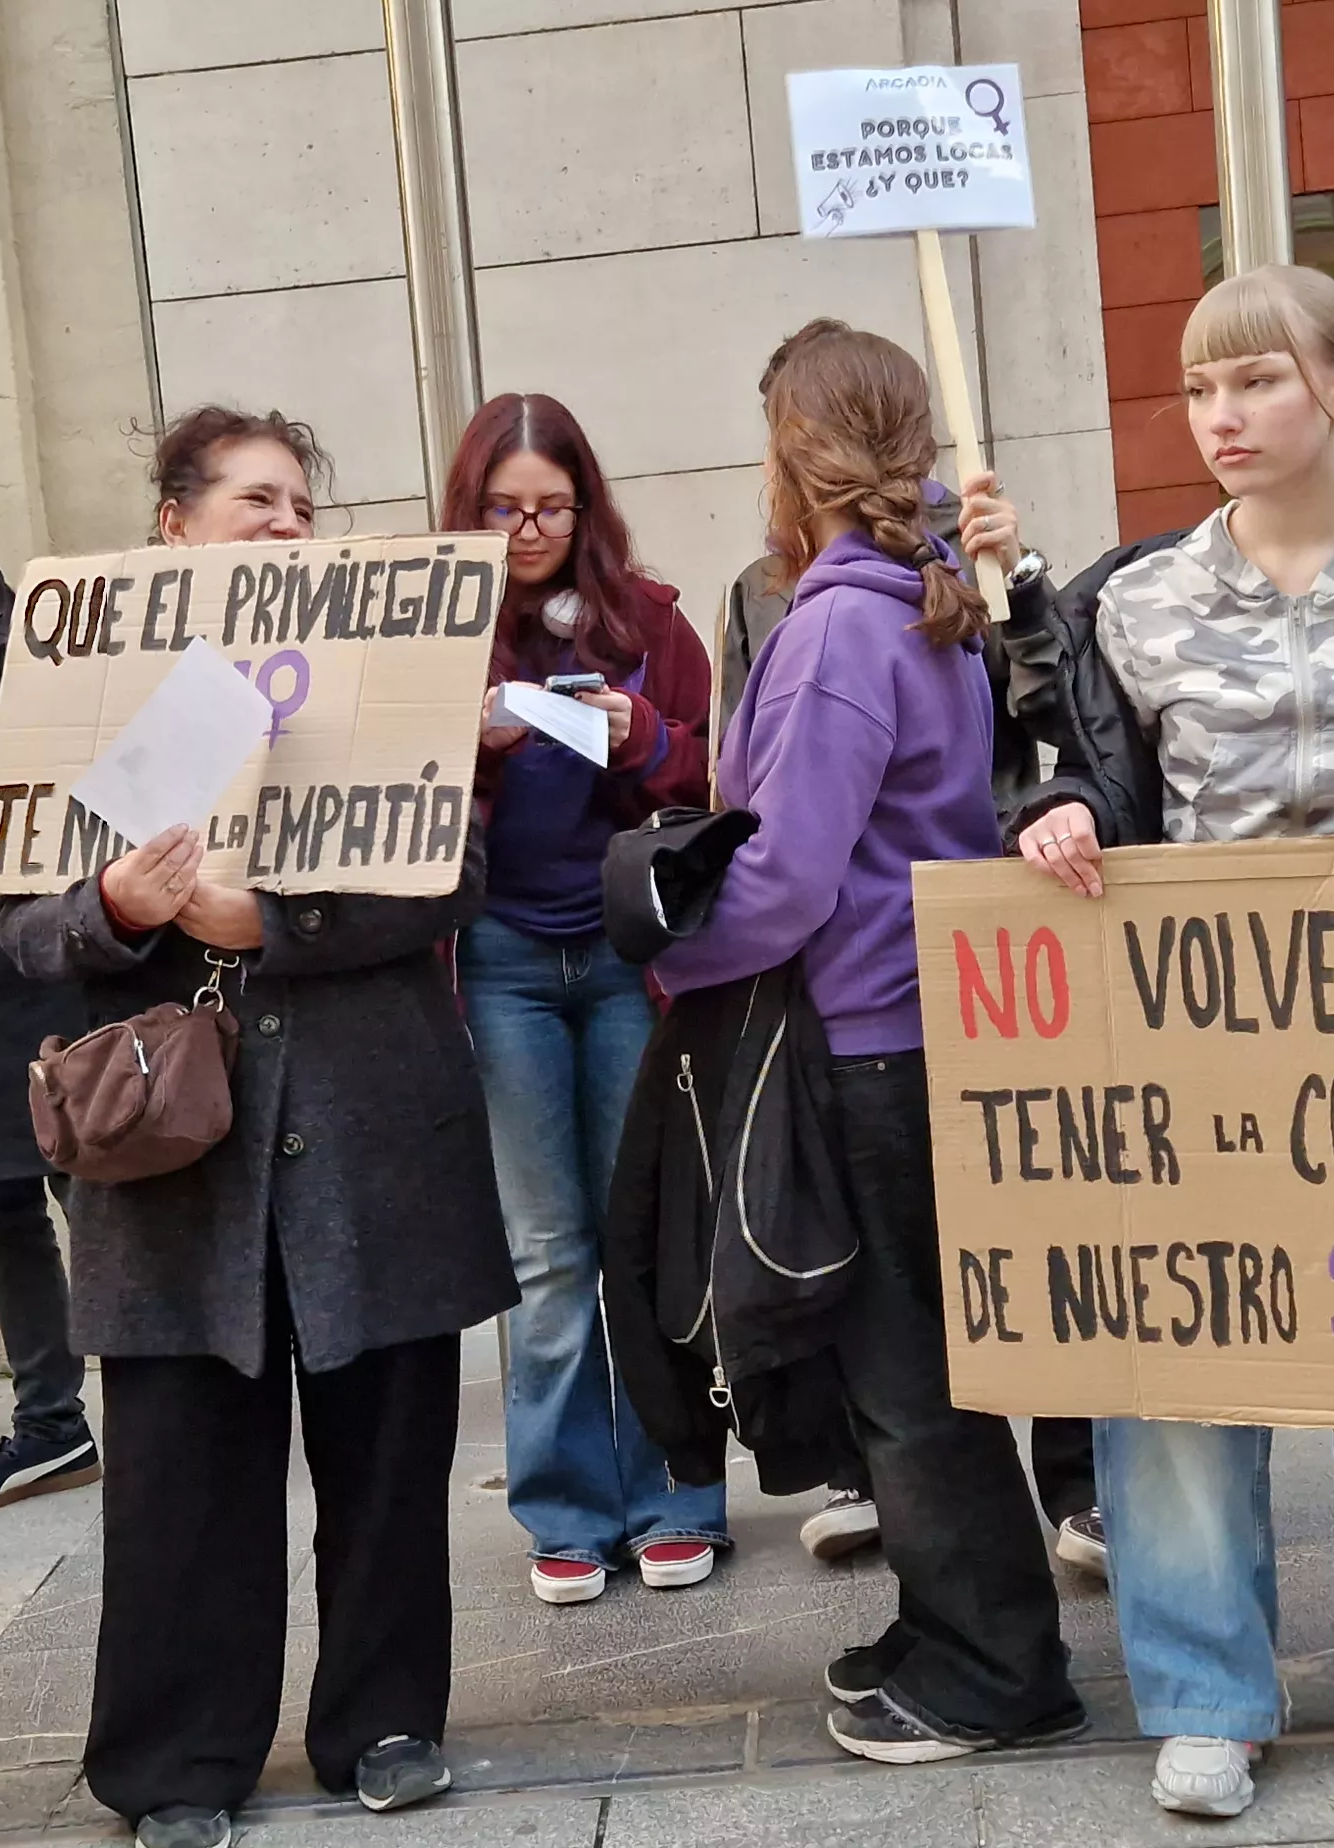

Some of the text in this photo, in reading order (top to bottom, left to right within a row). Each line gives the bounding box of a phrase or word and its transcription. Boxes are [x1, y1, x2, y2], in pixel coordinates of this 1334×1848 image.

[810, 142, 1013, 171] ESTAMOS LOCAS
[860, 116, 962, 140] PORQUE
[865, 168, 969, 198] ¿Y QUE?
[23, 576, 136, 666] QUE
[140, 568, 207, 652] EL
[206, 814, 248, 852] LA
[246, 760, 464, 878] EMPATÍA
[952, 926, 1069, 1039] NO
[960, 1083, 1181, 1186] TENER
[1214, 1112, 1263, 1154] LA
[959, 1247, 1023, 1344] DE
[1046, 1240, 1298, 1347] NUESTRO
